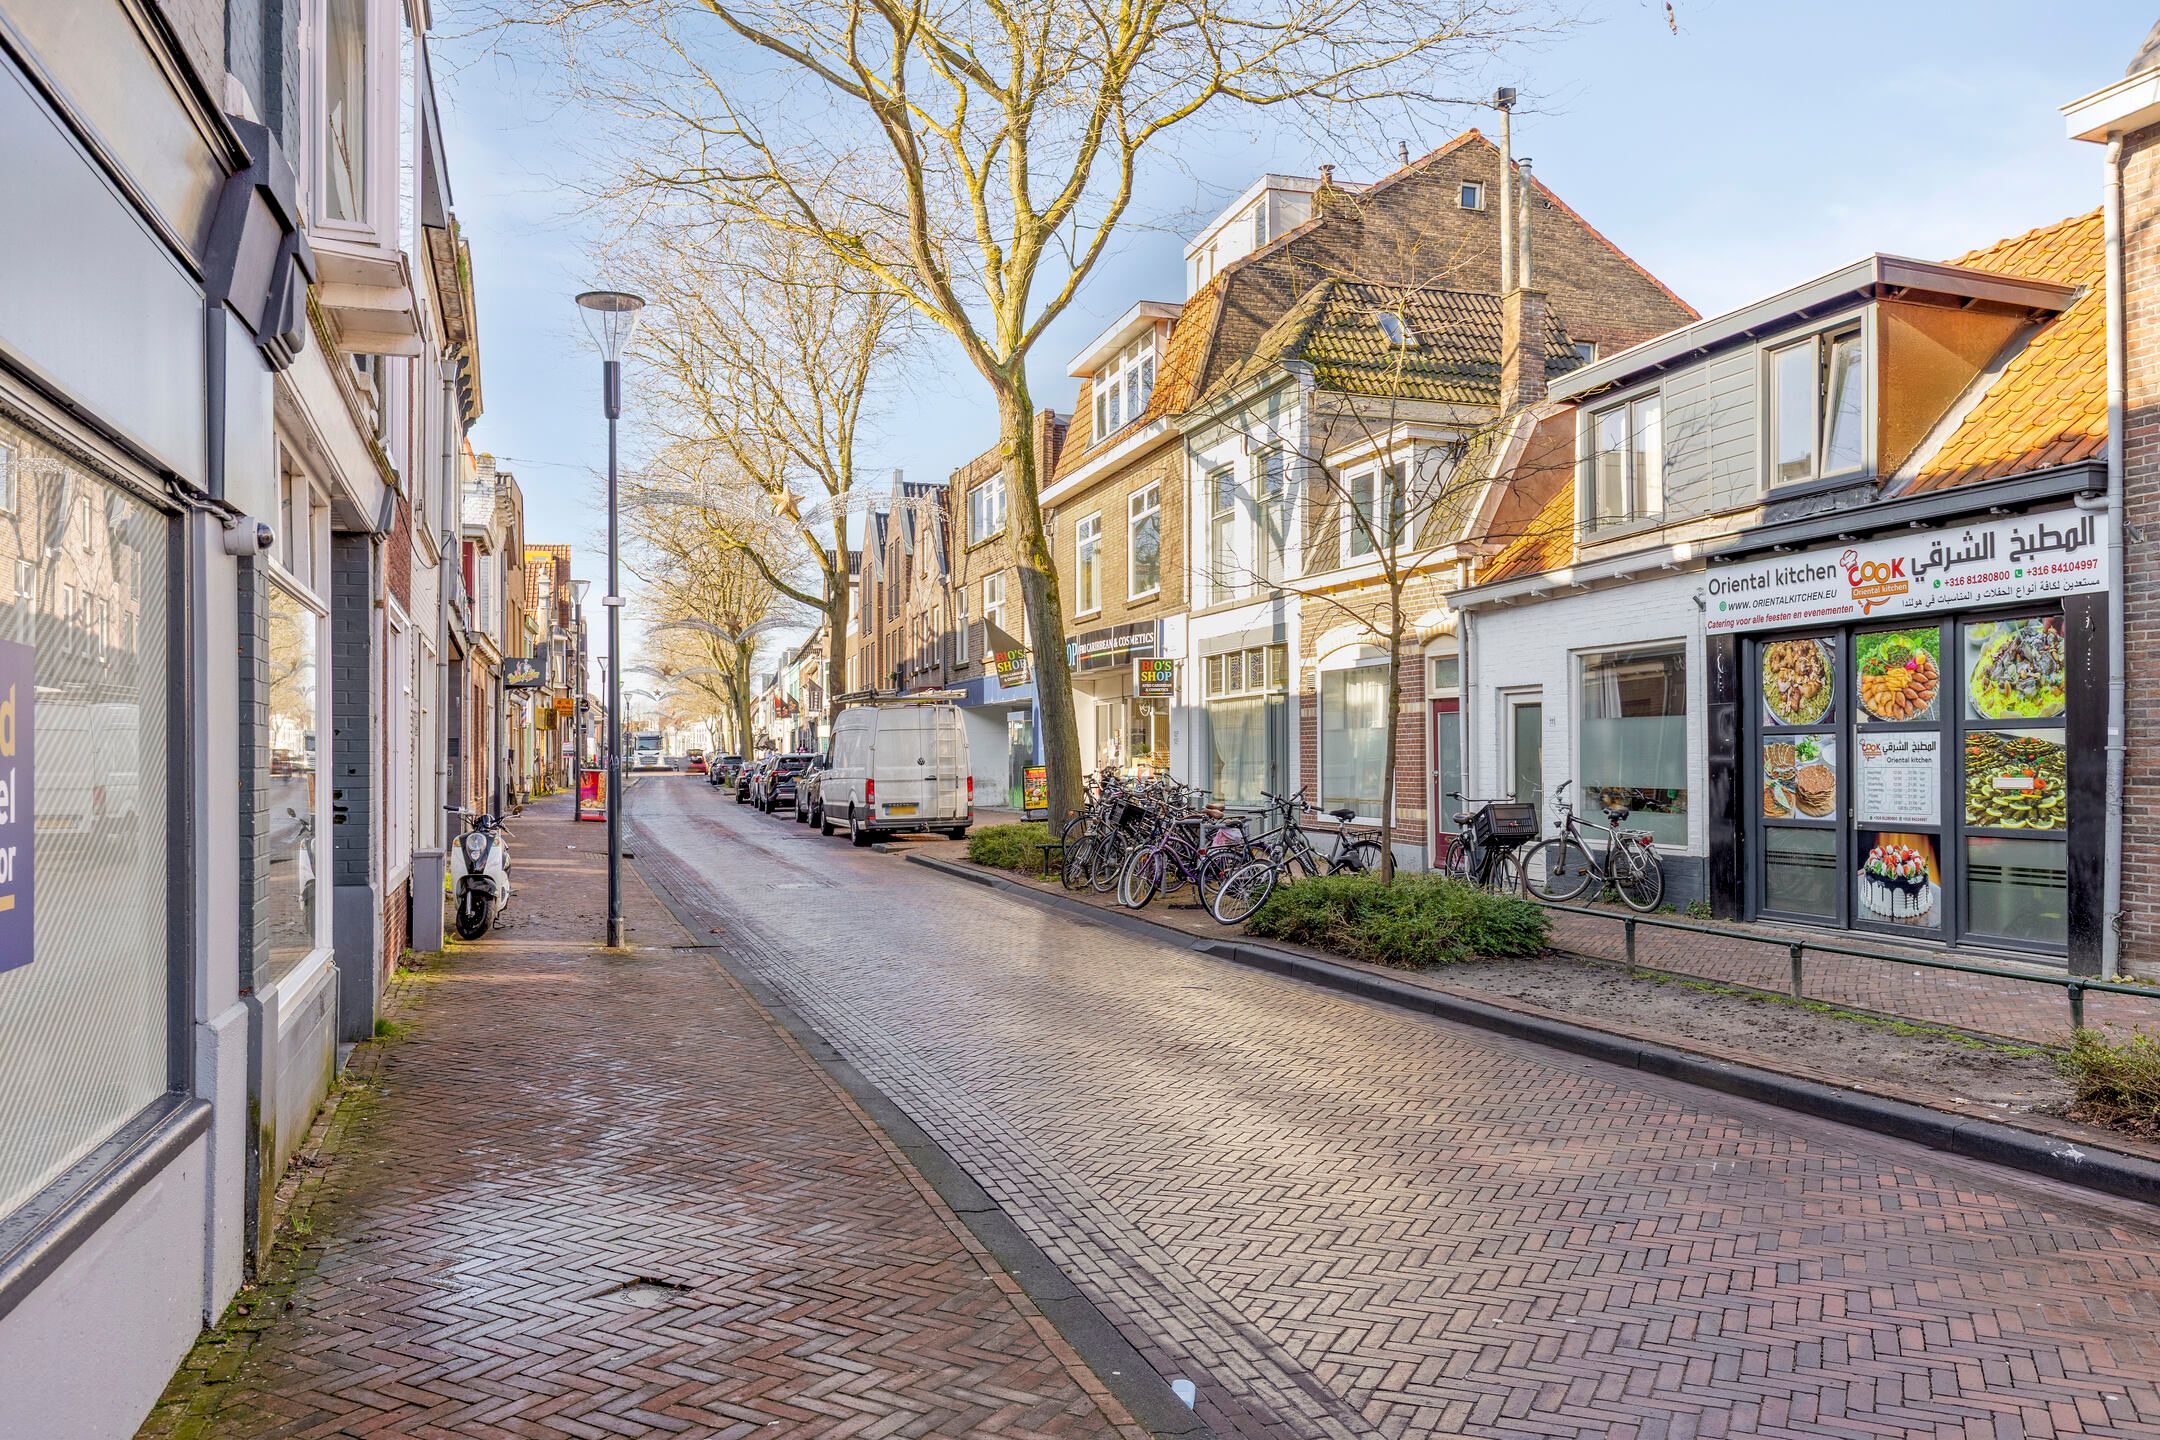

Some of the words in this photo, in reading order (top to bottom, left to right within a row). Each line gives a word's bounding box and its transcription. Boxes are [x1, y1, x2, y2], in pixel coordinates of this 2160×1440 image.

[2009, 515, 2095, 562] المطبخ
[1911, 531, 1995, 582] الشرقي
[2026, 565, 2049, 577] +316
[2051, 559, 2098, 574] 84104997
[1708, 570, 1770, 595] Oriental
[1775, 564, 1837, 586] kitchen
[1848, 557, 1905, 586] COOK
[1944, 577, 1965, 588] +316
[1966, 570, 2010, 586] 81280800
[1853, 587, 1881, 597] Oriental
[1881, 584, 1908, 593] kitchen
[1707, 618, 1734, 630] Catering
[1736, 617, 1751, 625] voor
[1752, 614, 1764, 624] alle
[1765, 611, 1791, 622] feesten
[1793, 610, 1802, 619] en
[1803, 605, 1854, 618] evenementen
[1066, 643, 1077, 667] OP
[1087, 638, 1114, 652] CARIBBEAN
[1119, 632, 1154, 647] COSMETICS
[1141, 661, 1172, 671] BIO'S
[1141, 671, 1172, 681] SHOP
